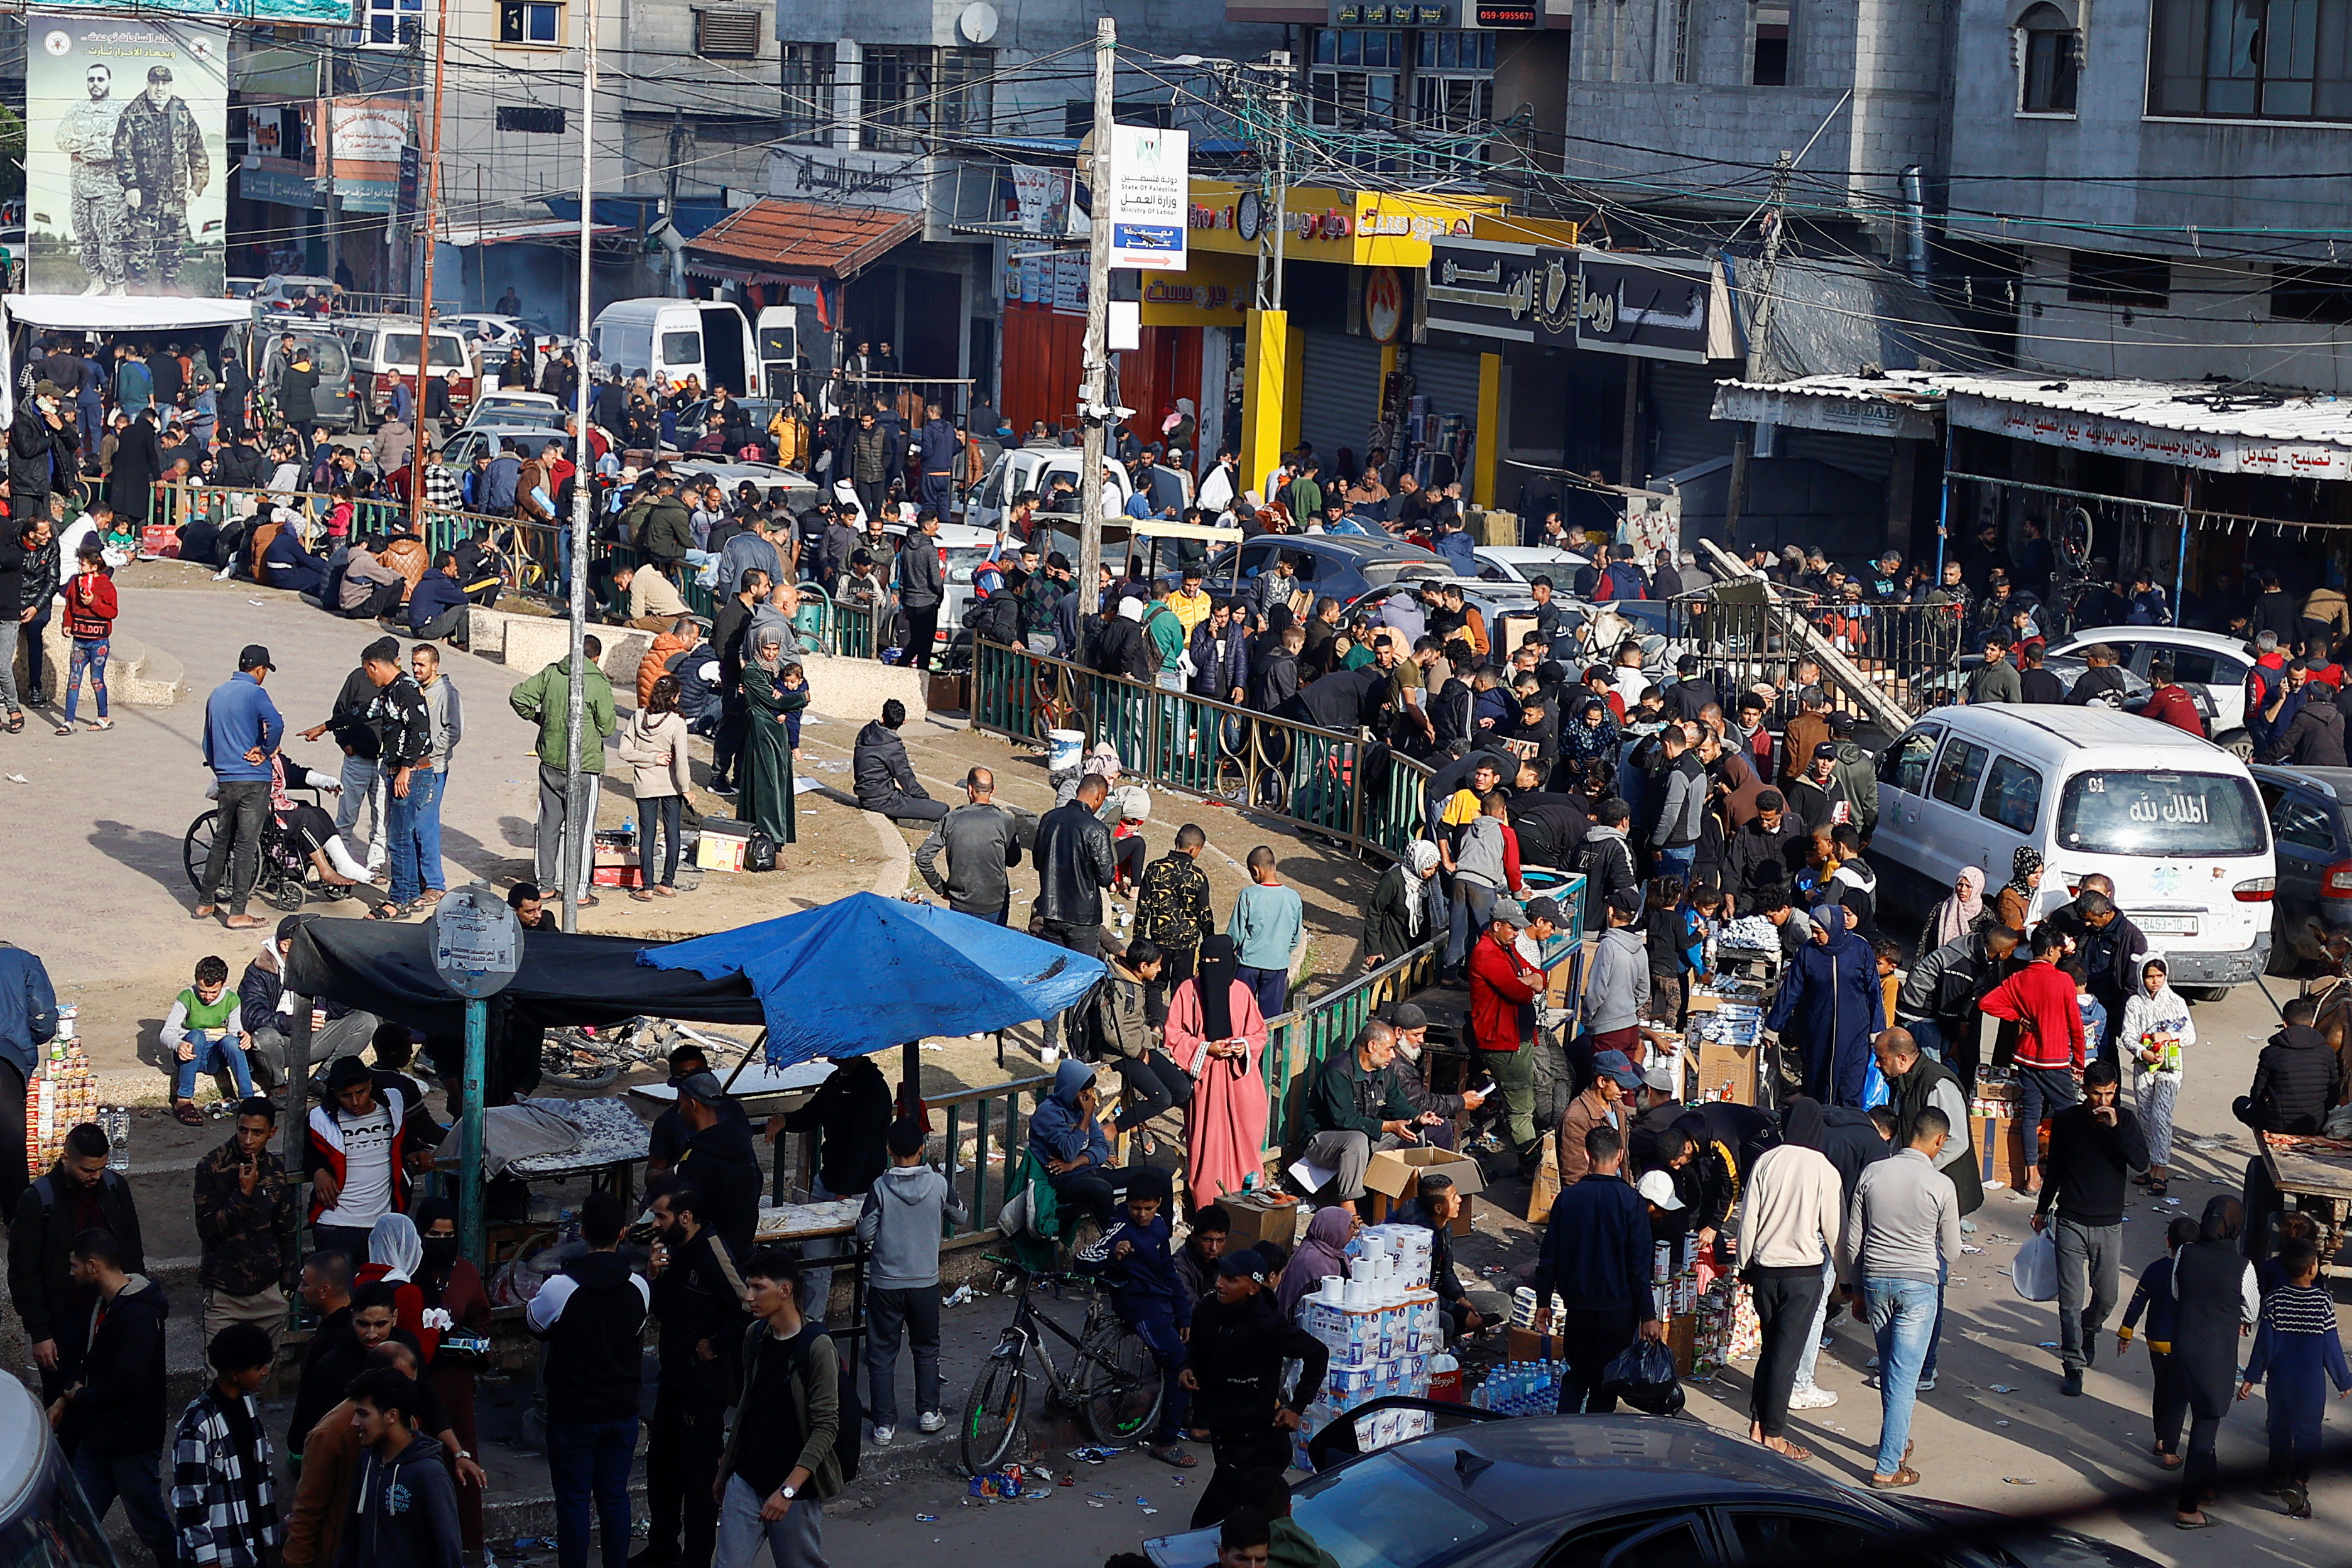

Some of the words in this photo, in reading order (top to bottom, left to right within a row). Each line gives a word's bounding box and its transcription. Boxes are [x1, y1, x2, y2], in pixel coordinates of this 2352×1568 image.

[1481, 11, 1533, 20] 059-9955678
[144, 48, 177, 60] وبجهاد
[1121, 174, 1160, 183] فلسطين
[1161, 175, 1177, 185] دولة
[1121, 193, 1155, 206] العمل
[1158, 195, 1177, 209] وزارة
[1121, 207, 1146, 215] Ministry
[1861, 403, 1897, 420] DAB
[2242, 445, 2278, 468] تبديل
[2088, 777, 2105, 793] 01
[2163, 793, 2209, 824] الملك
